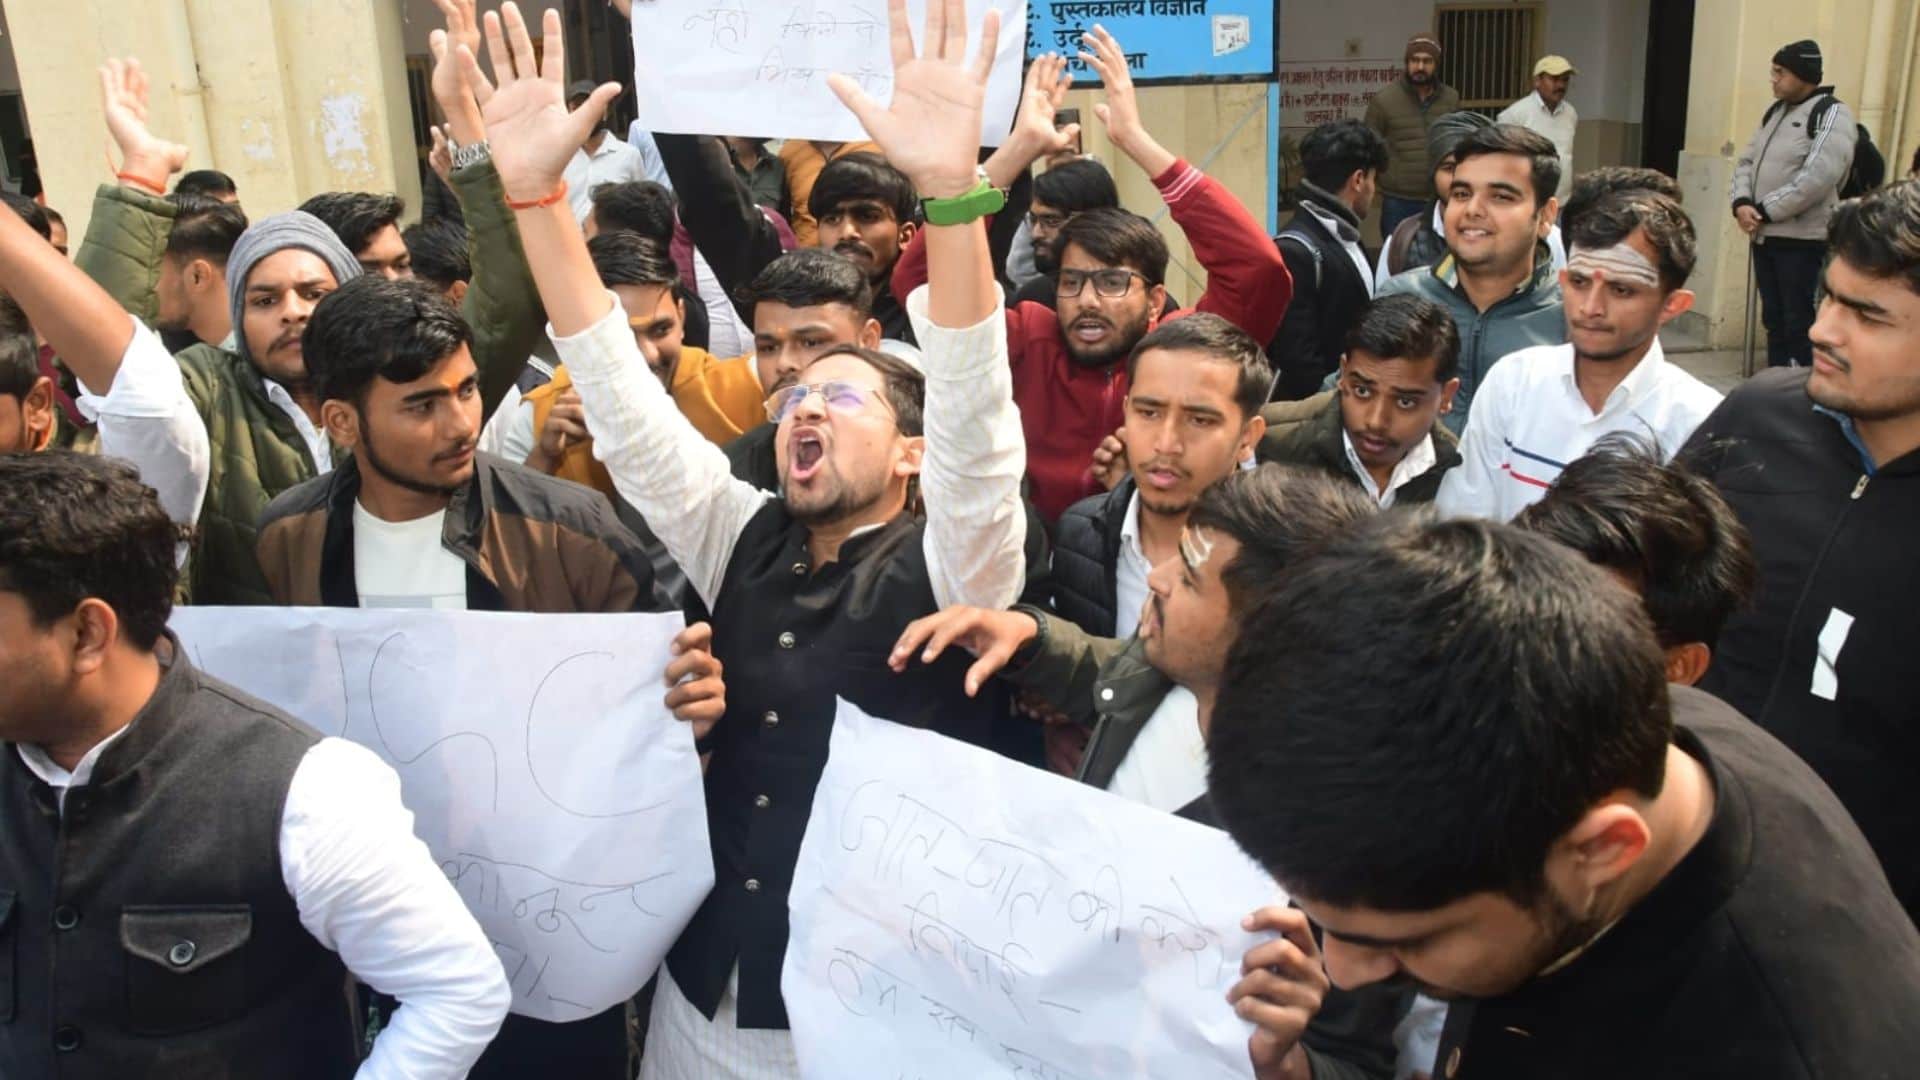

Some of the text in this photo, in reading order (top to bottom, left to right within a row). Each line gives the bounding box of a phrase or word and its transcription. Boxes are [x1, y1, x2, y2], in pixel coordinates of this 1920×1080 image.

[1050, 0, 1145, 25] पुस्तकालय
[1151, 0, 1206, 20] विज्ञान
[1053, 22, 1090, 52] उर्दू
[1068, 865, 1123, 943] की
